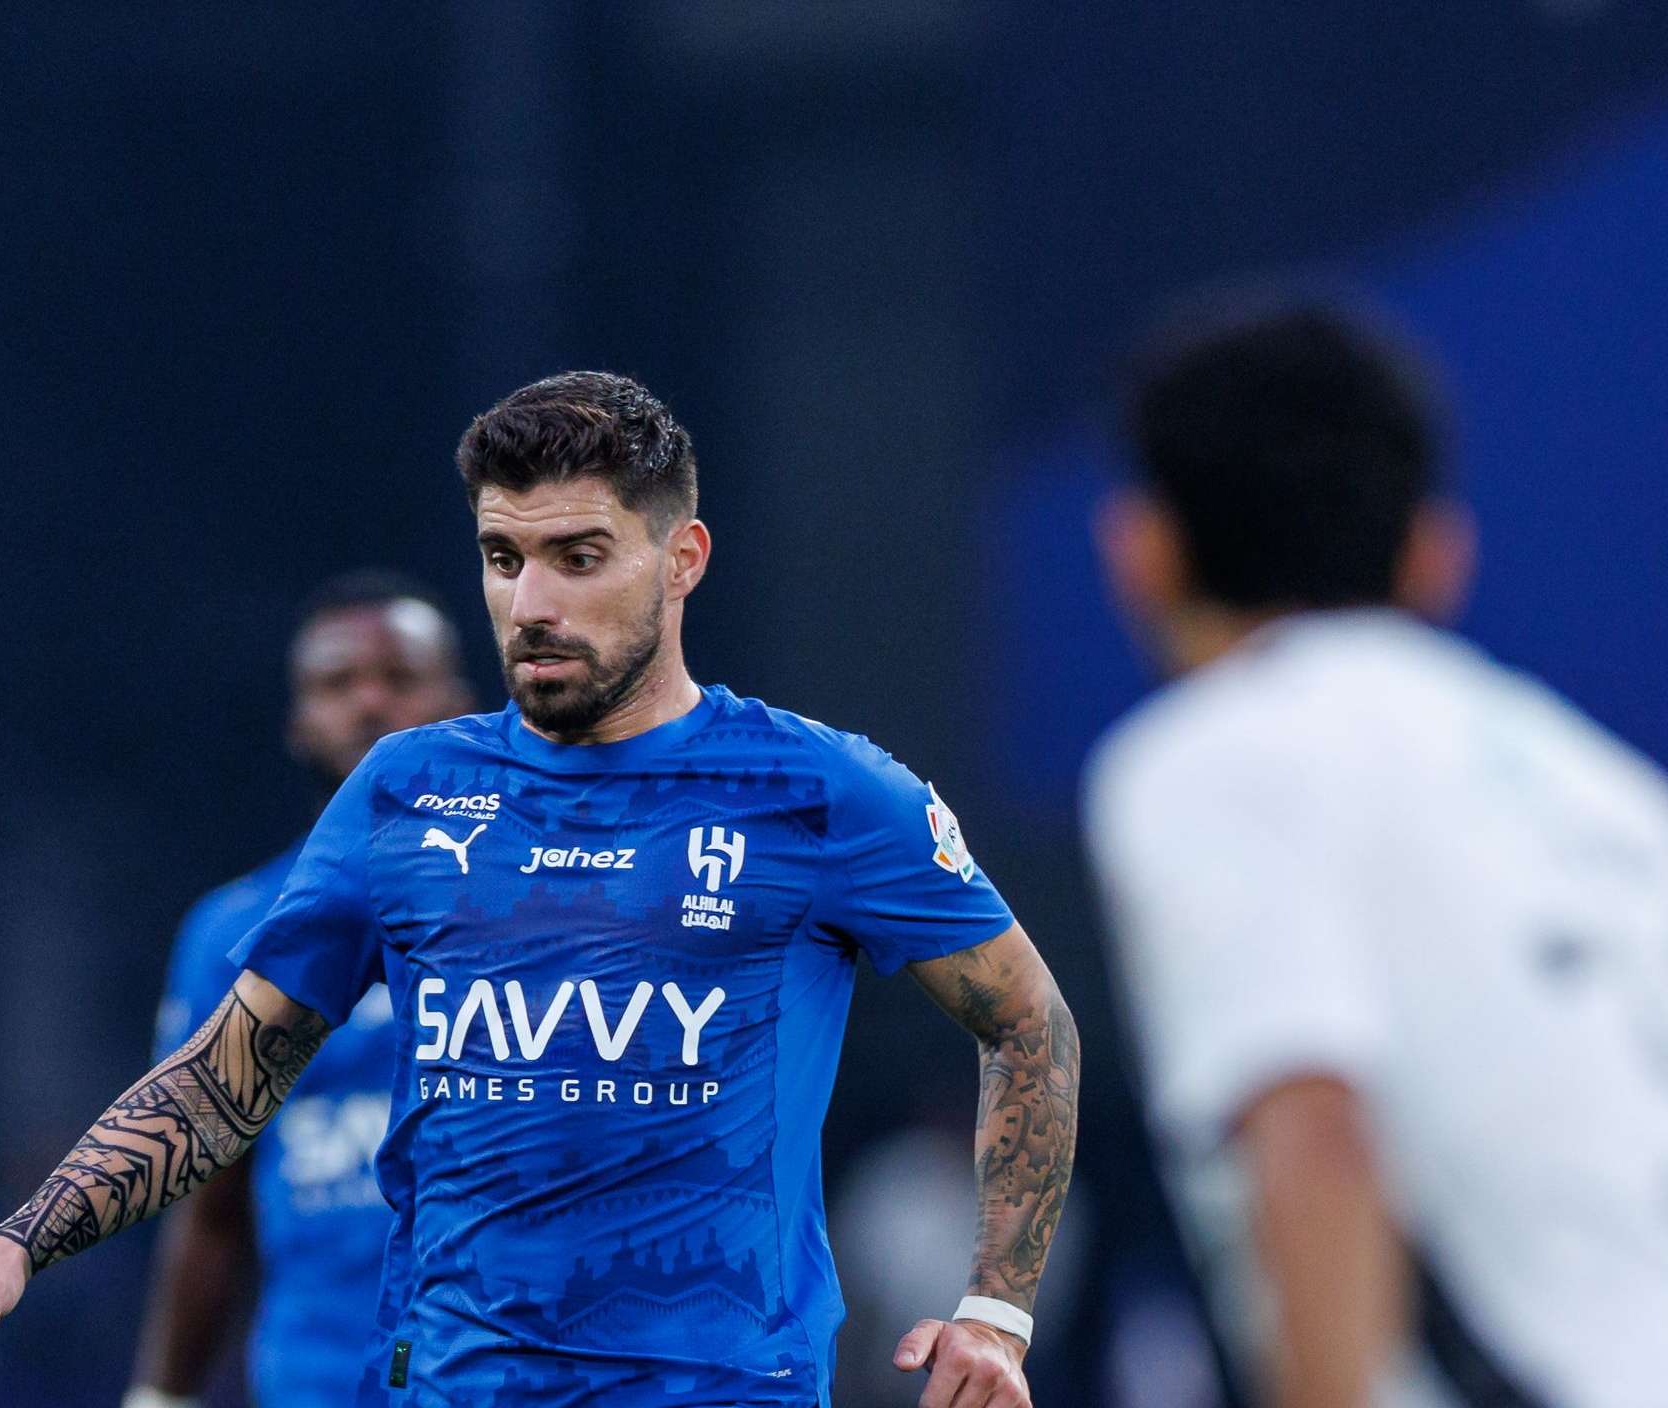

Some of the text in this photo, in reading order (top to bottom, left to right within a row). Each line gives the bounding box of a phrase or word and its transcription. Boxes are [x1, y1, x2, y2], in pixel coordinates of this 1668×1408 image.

[415, 977, 727, 1067] SAVVY
[419, 1075, 720, 1106] GAMES GROUP
